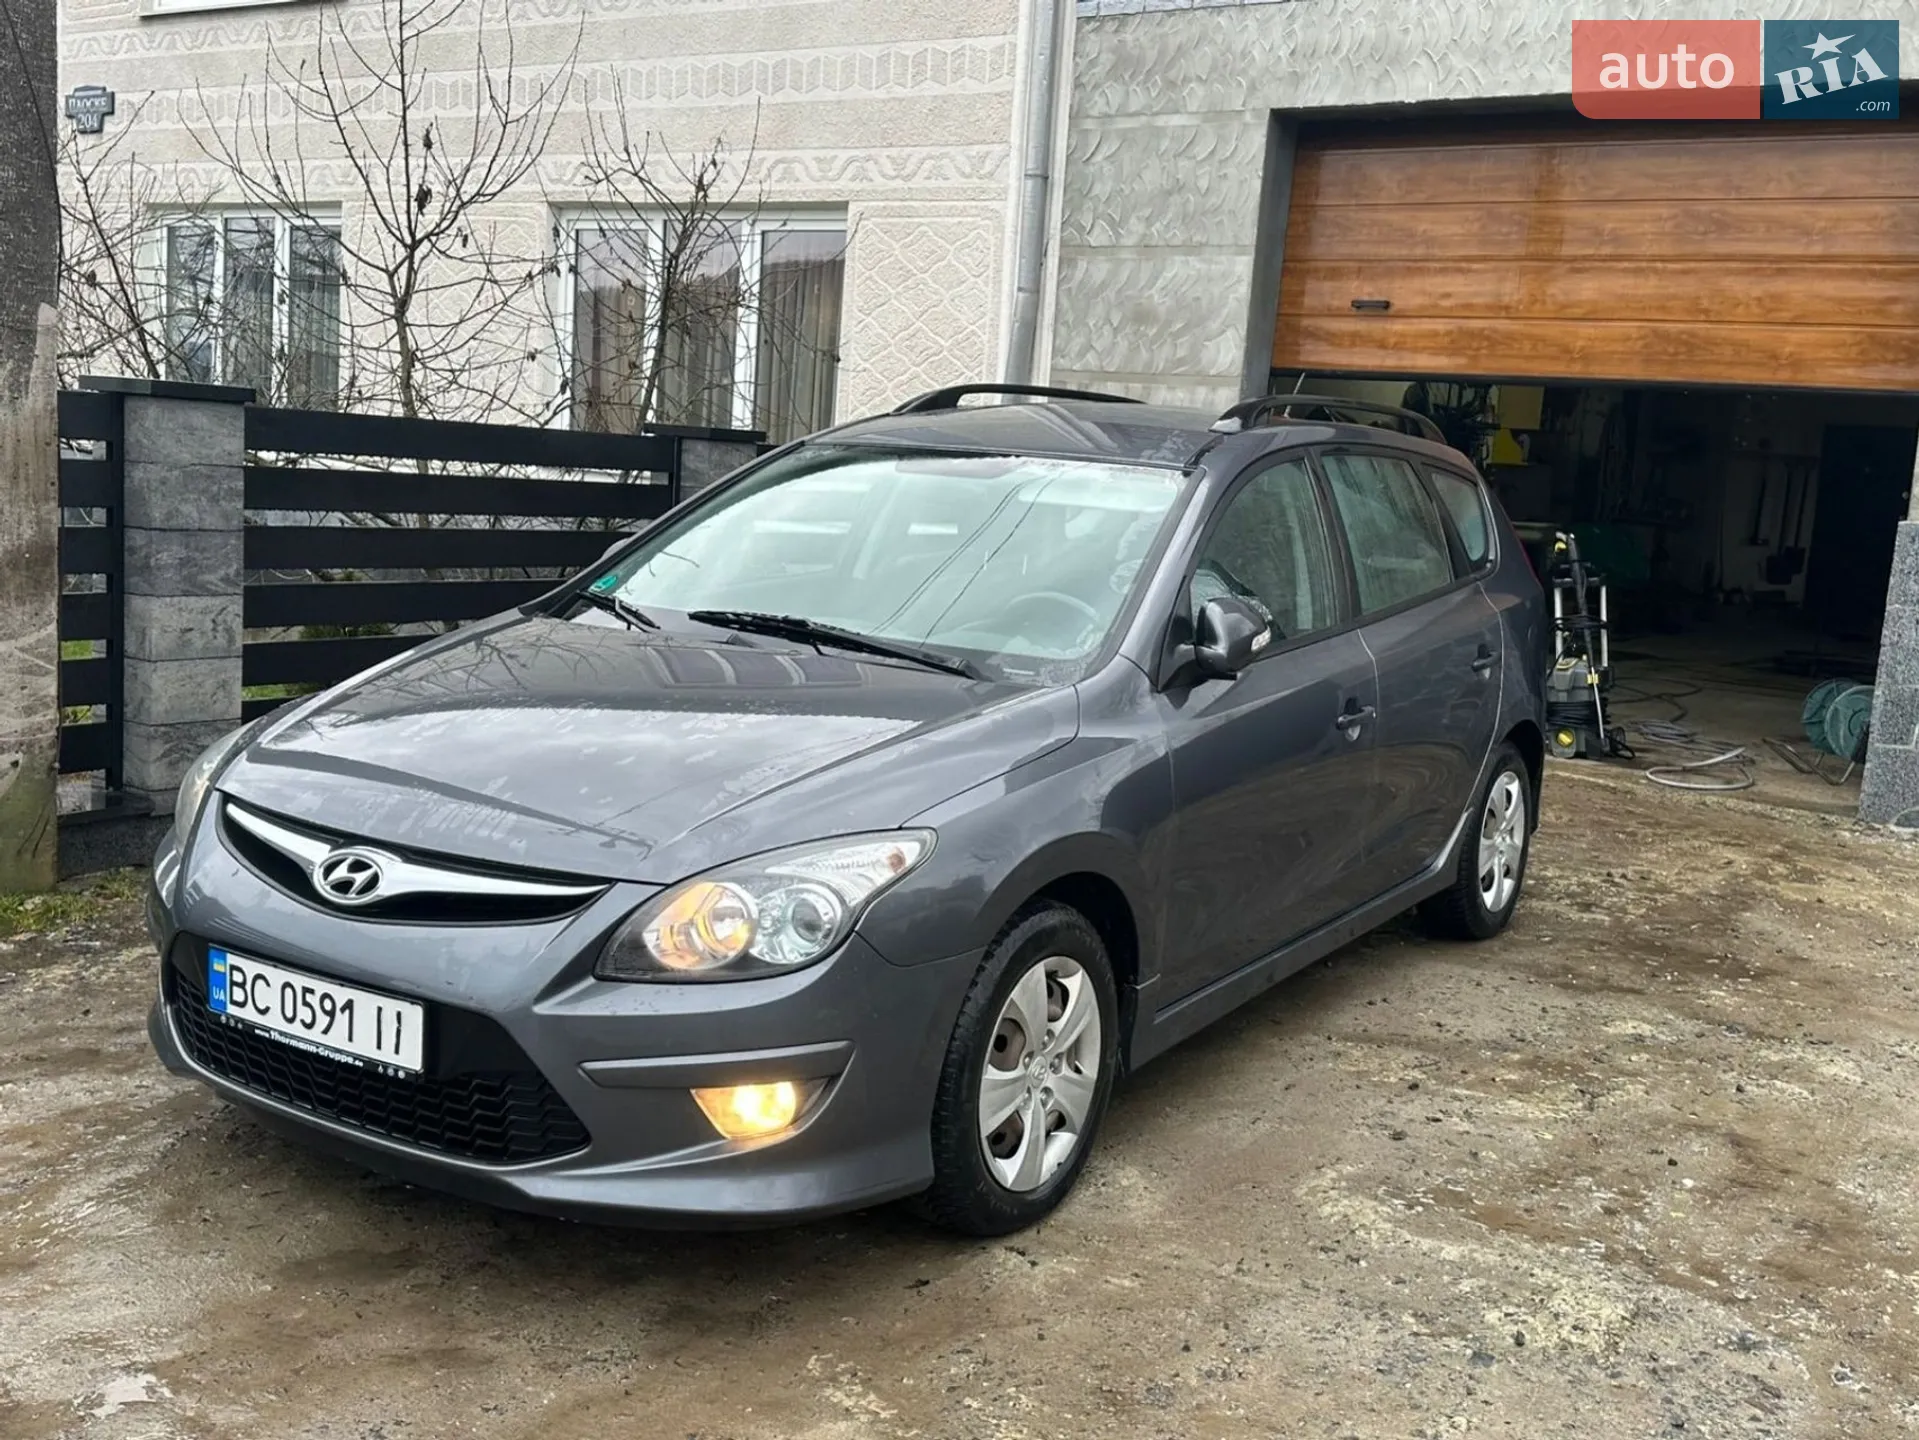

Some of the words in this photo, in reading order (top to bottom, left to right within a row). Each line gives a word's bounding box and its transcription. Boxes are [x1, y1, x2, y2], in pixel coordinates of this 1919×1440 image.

[77, 113, 98, 129] 204
[212, 986, 226, 1003] UA
[229, 963, 271, 1016] BC
[280, 981, 355, 1043] 0591
